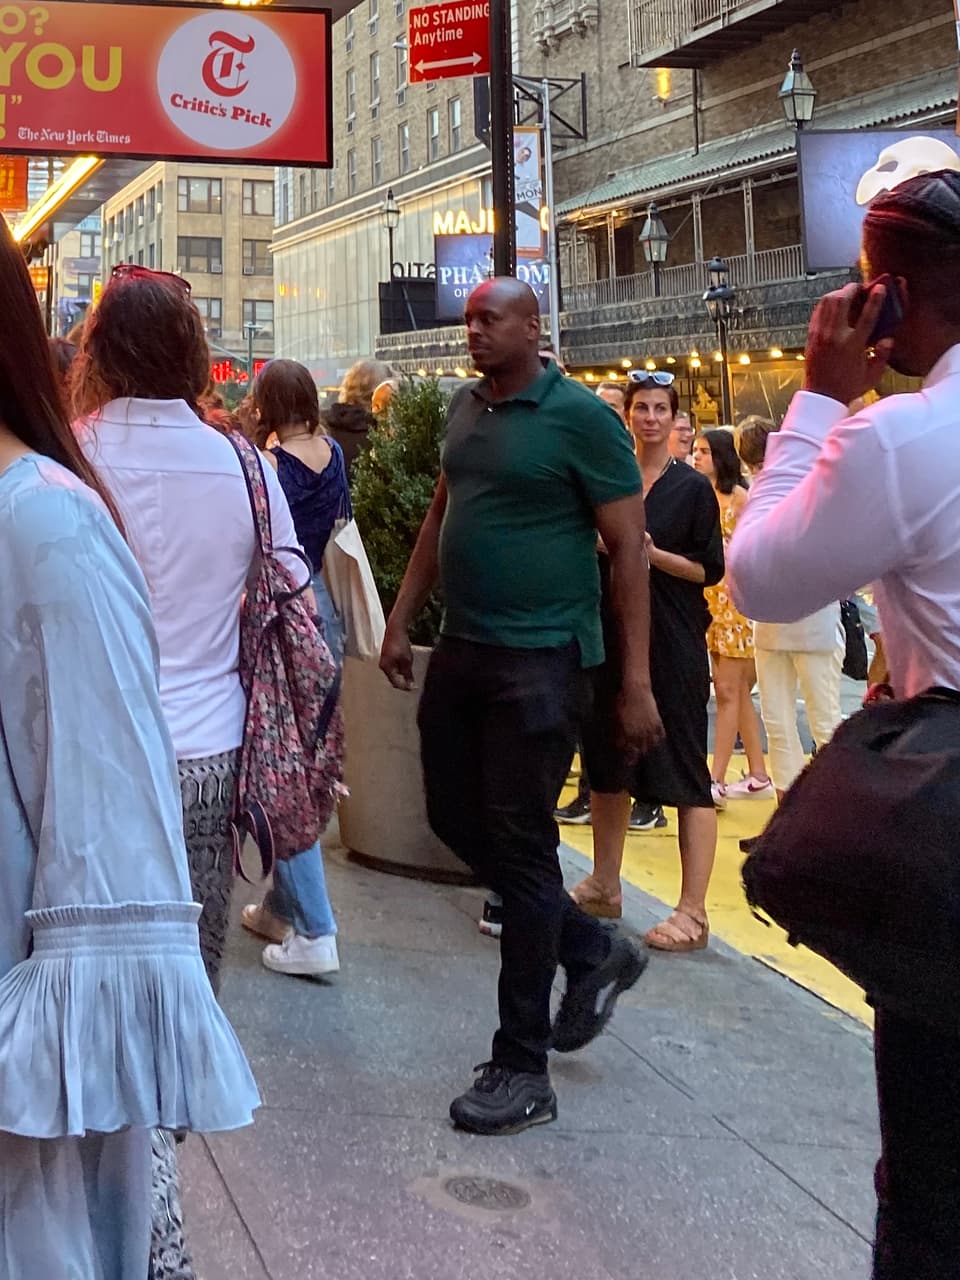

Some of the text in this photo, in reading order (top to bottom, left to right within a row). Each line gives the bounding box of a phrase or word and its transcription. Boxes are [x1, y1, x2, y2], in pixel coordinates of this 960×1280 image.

[413, 2, 490, 29] NO STANDING
[414, 27, 463, 48] Anytime
[170, 93, 272, 128] Critic's Pick
[18, 126, 131, 145] The New York Times
[440, 263, 550, 286] PHAOM
